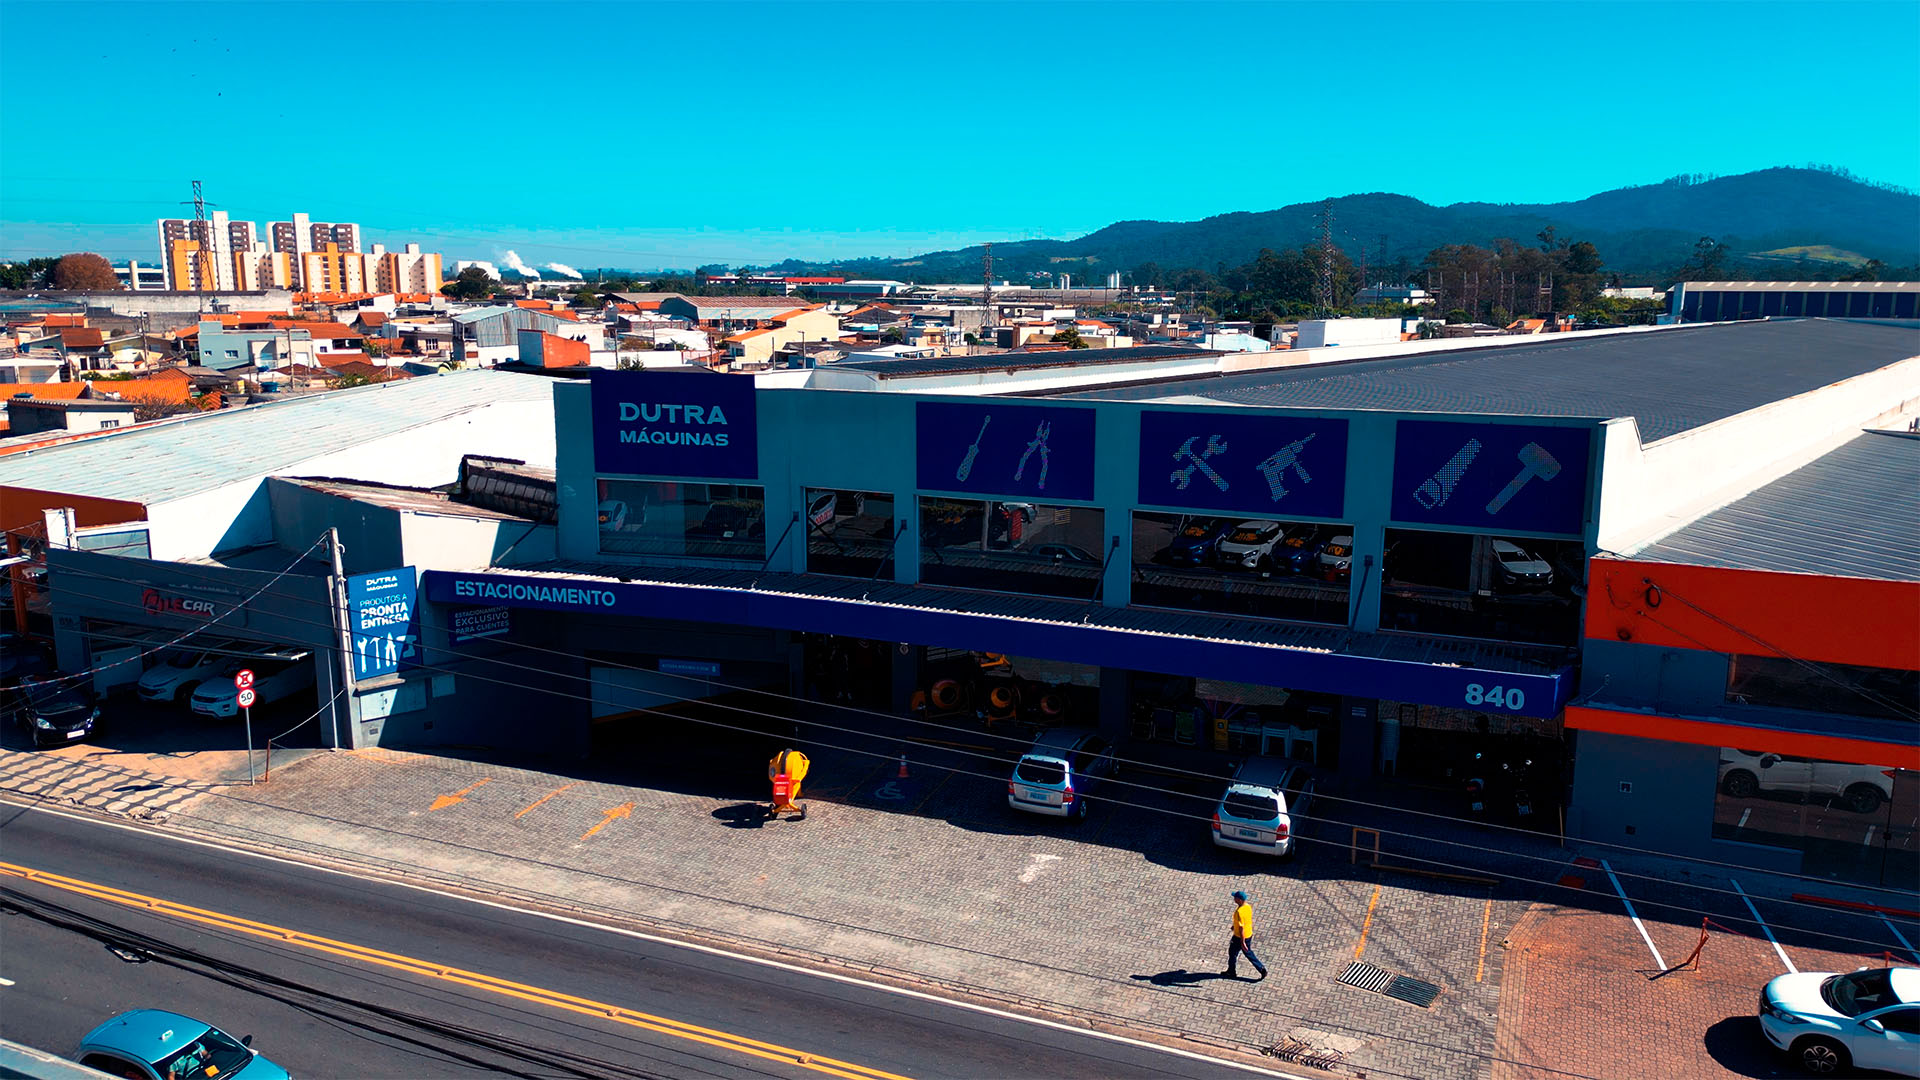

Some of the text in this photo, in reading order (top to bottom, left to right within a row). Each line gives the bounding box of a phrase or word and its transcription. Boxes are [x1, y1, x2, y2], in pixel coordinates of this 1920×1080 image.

[619, 402, 728, 425] DUTRA
[620, 427, 729, 446] MÁQUINAS
[366, 575, 398, 586] DUTRA
[360, 594, 401, 607] PRODUTOS
[455, 580, 616, 606] ESTACIONAMENTO
[360, 601, 408, 619] PRONTA
[361, 612, 410, 629] ENTREGA
[455, 611, 509, 627] EXCLUSIVO
[456, 619, 510, 635] PARA CLIENTES
[241, 692, 252, 702] 50
[1464, 683, 1525, 710] 840
